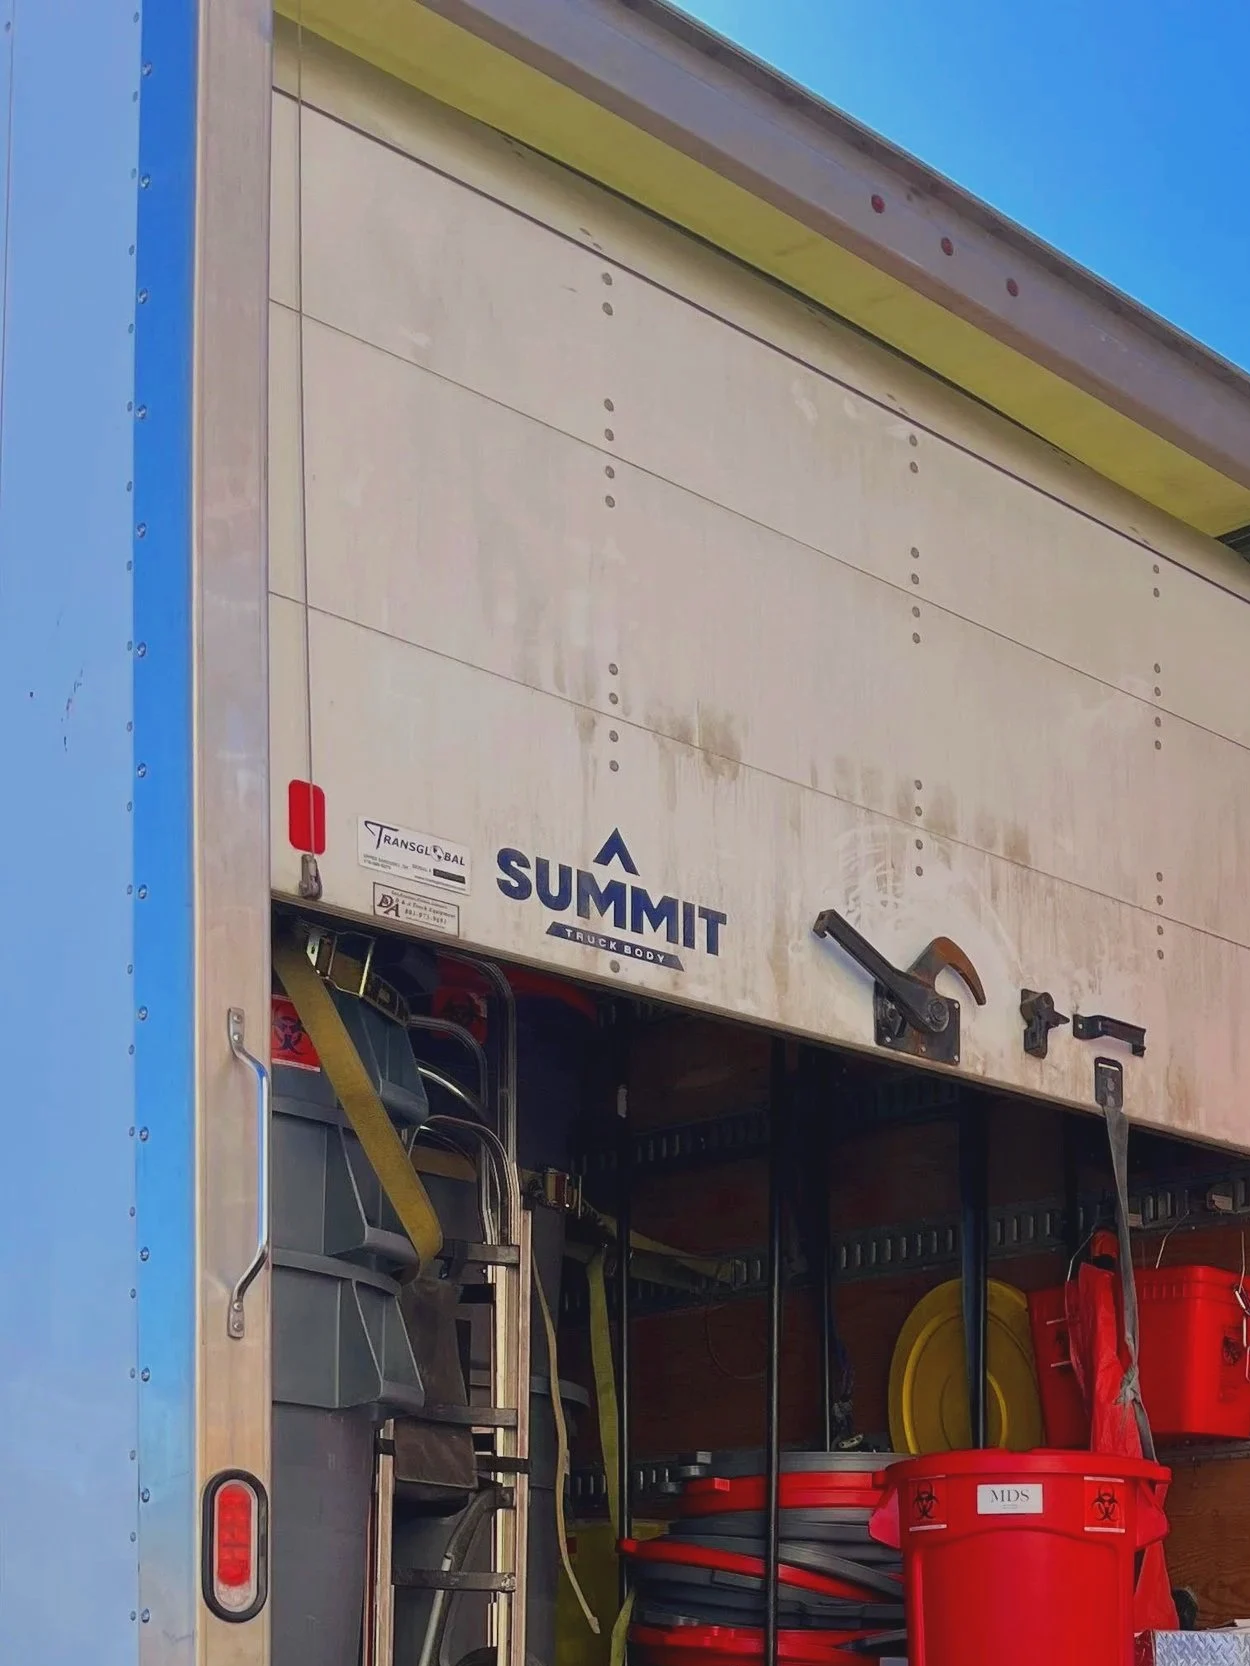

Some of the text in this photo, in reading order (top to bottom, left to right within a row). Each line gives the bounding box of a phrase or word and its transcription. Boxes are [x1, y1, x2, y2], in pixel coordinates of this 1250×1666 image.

[364, 820, 465, 866] TRANSGLOBAL
[496, 847, 727, 956] SUMMIT
[565, 929, 665, 963] TRUCK BODY
[989, 1489, 1030, 1503] MDS
